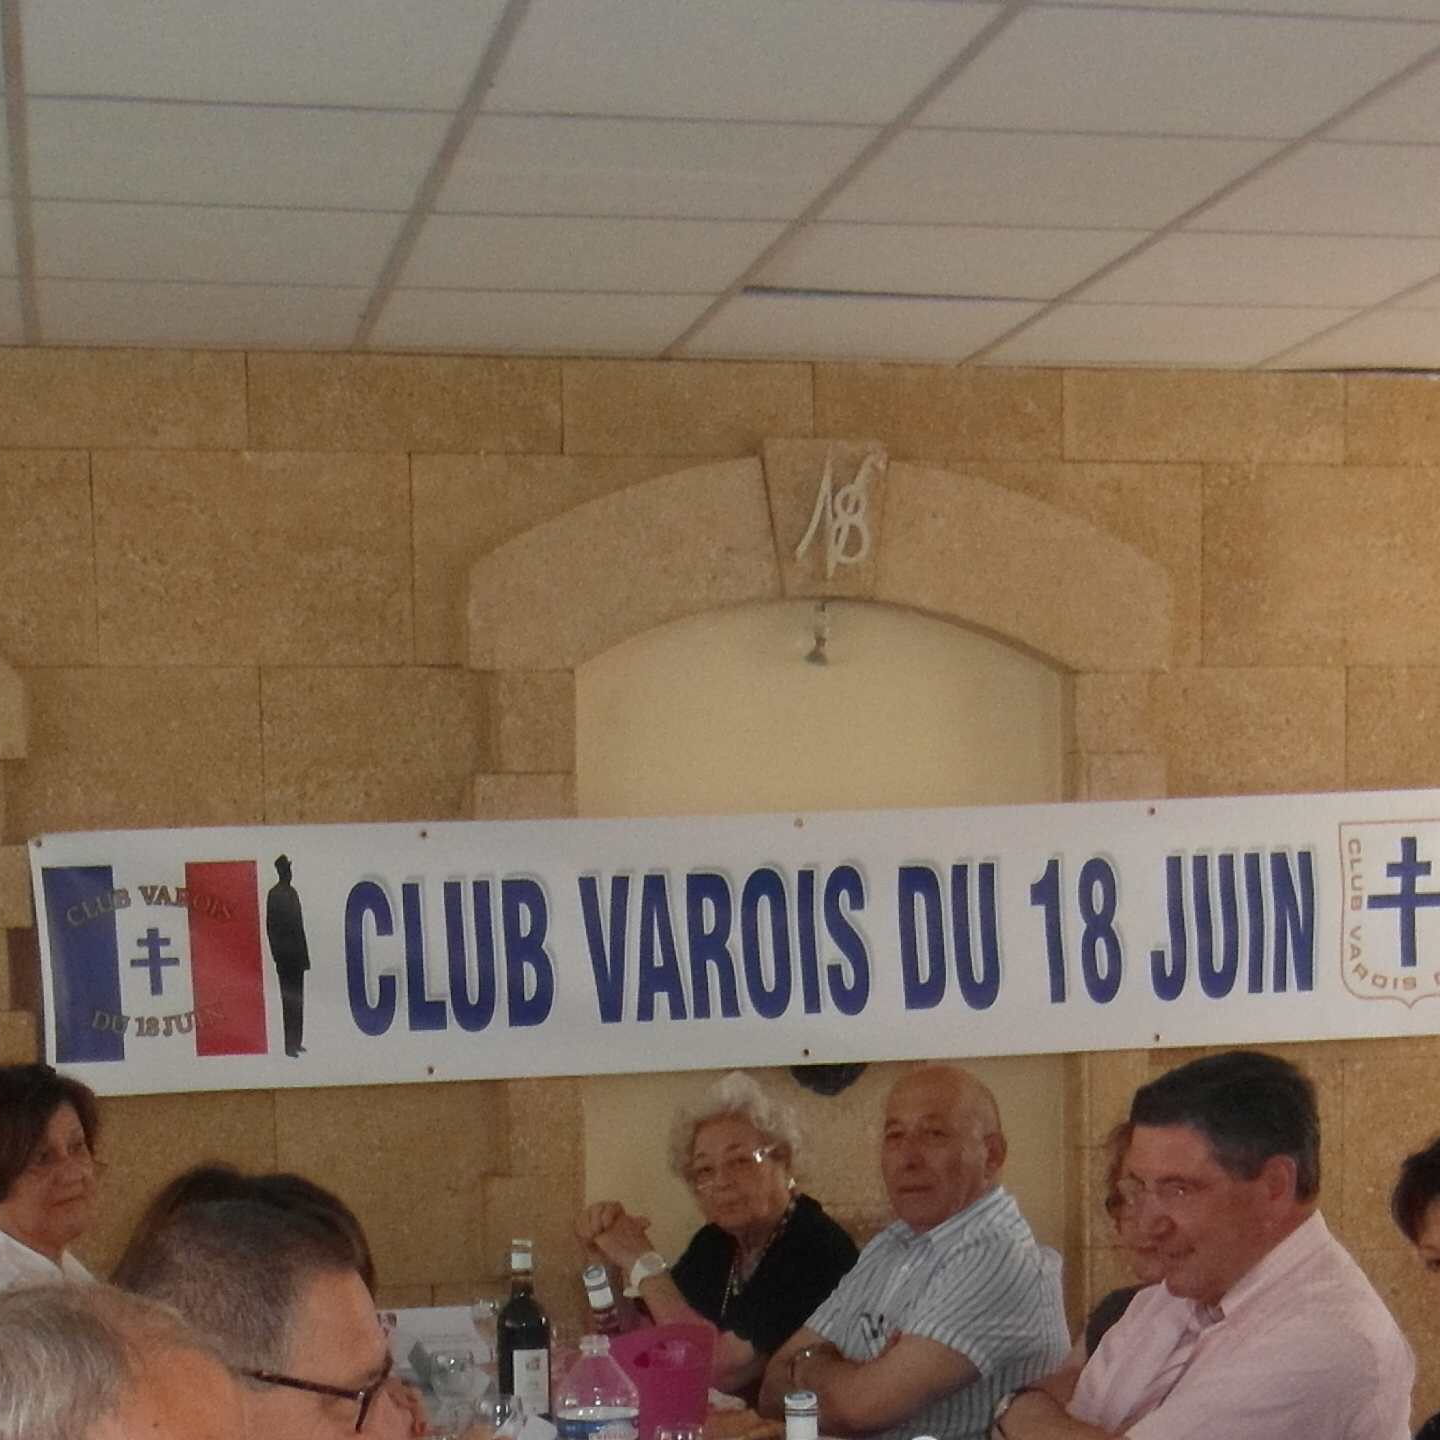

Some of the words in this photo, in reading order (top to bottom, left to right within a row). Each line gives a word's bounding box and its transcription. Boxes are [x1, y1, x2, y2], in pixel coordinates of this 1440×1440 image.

[1347, 838, 1363, 911] CLUB
[66, 888, 132, 927] CLUB
[344, 879, 555, 1037] CLUB
[579, 865, 871, 1024] VAROIS
[897, 863, 1001, 1010] DU
[1030, 858, 1122, 1004] 18
[1150, 852, 1315, 1001] JUIN
[1348, 925, 1417, 990] VAROIS
[92, 1010, 131, 1035] DU
[135, 1016, 160, 1037] 18
